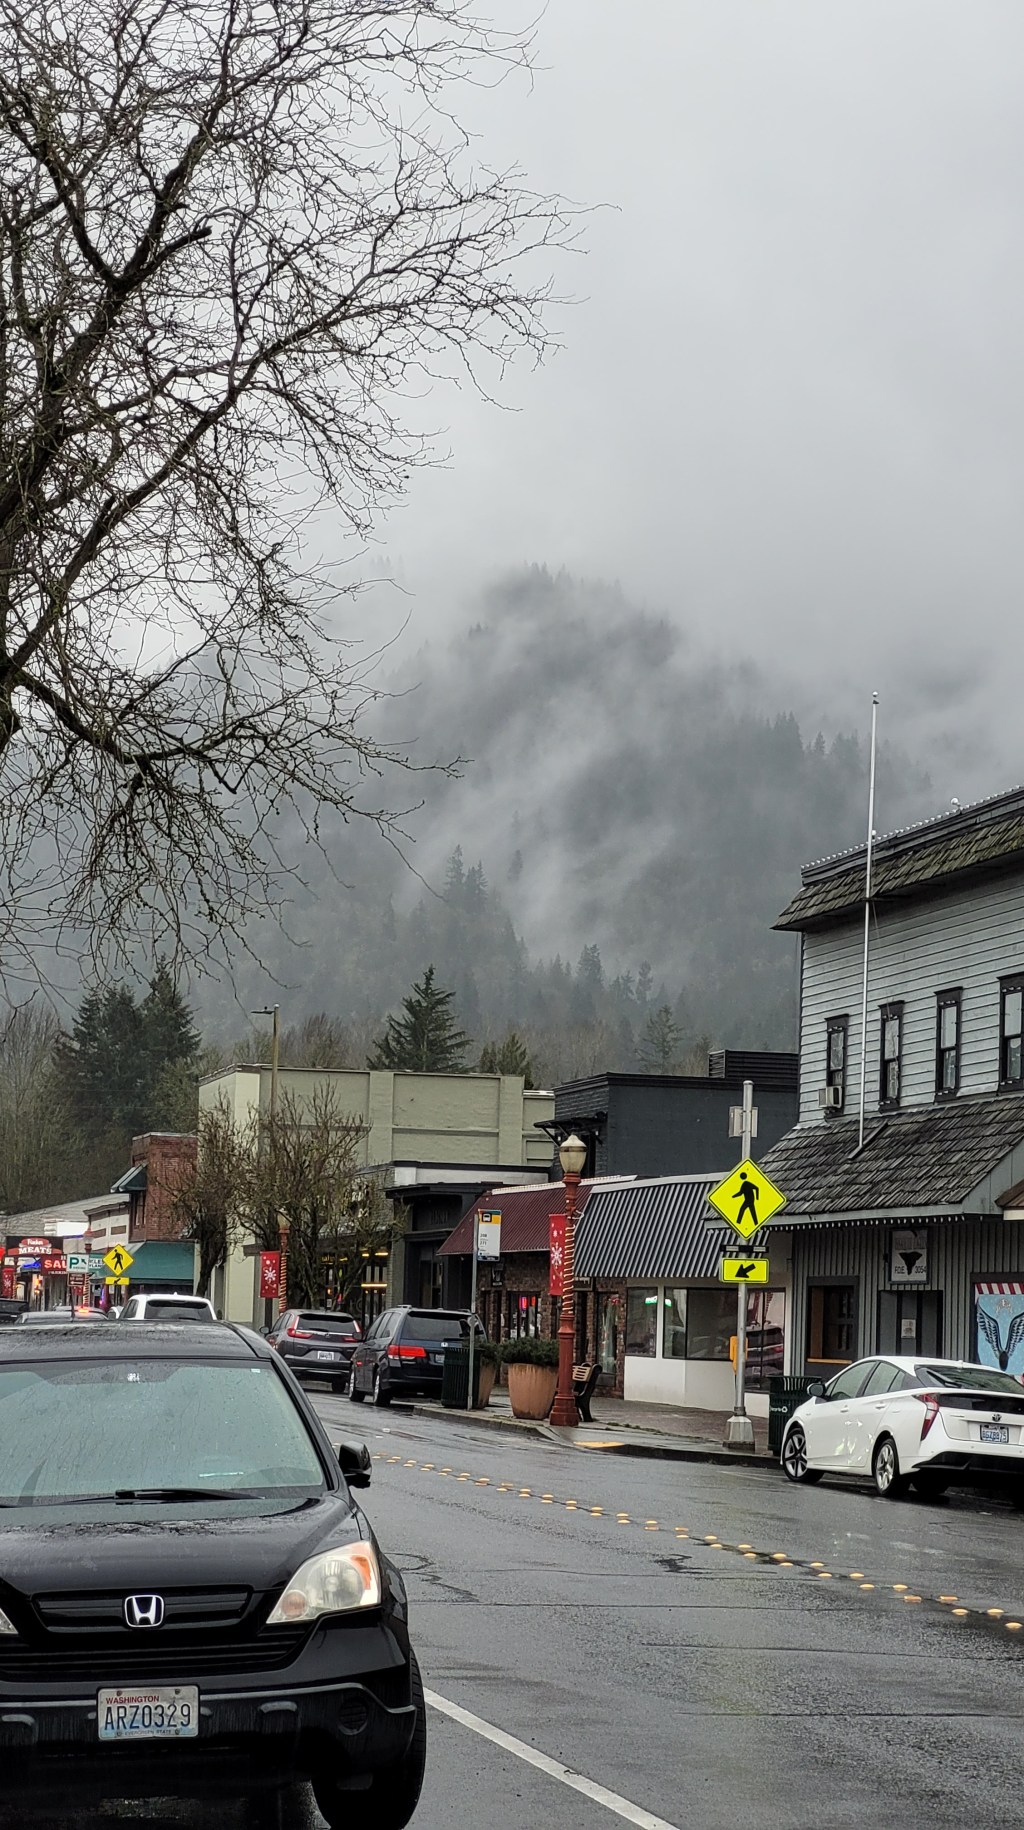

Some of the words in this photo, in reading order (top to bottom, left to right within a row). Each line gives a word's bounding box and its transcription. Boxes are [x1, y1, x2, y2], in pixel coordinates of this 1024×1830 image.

[18, 1246, 52, 1254] MEATS
[44, 1259, 67, 1269] SAL
[69, 1257, 79, 1269] P
[105, 1695, 160, 1704] WASHINGTON
[104, 1703, 191, 1731] ARZ0329
